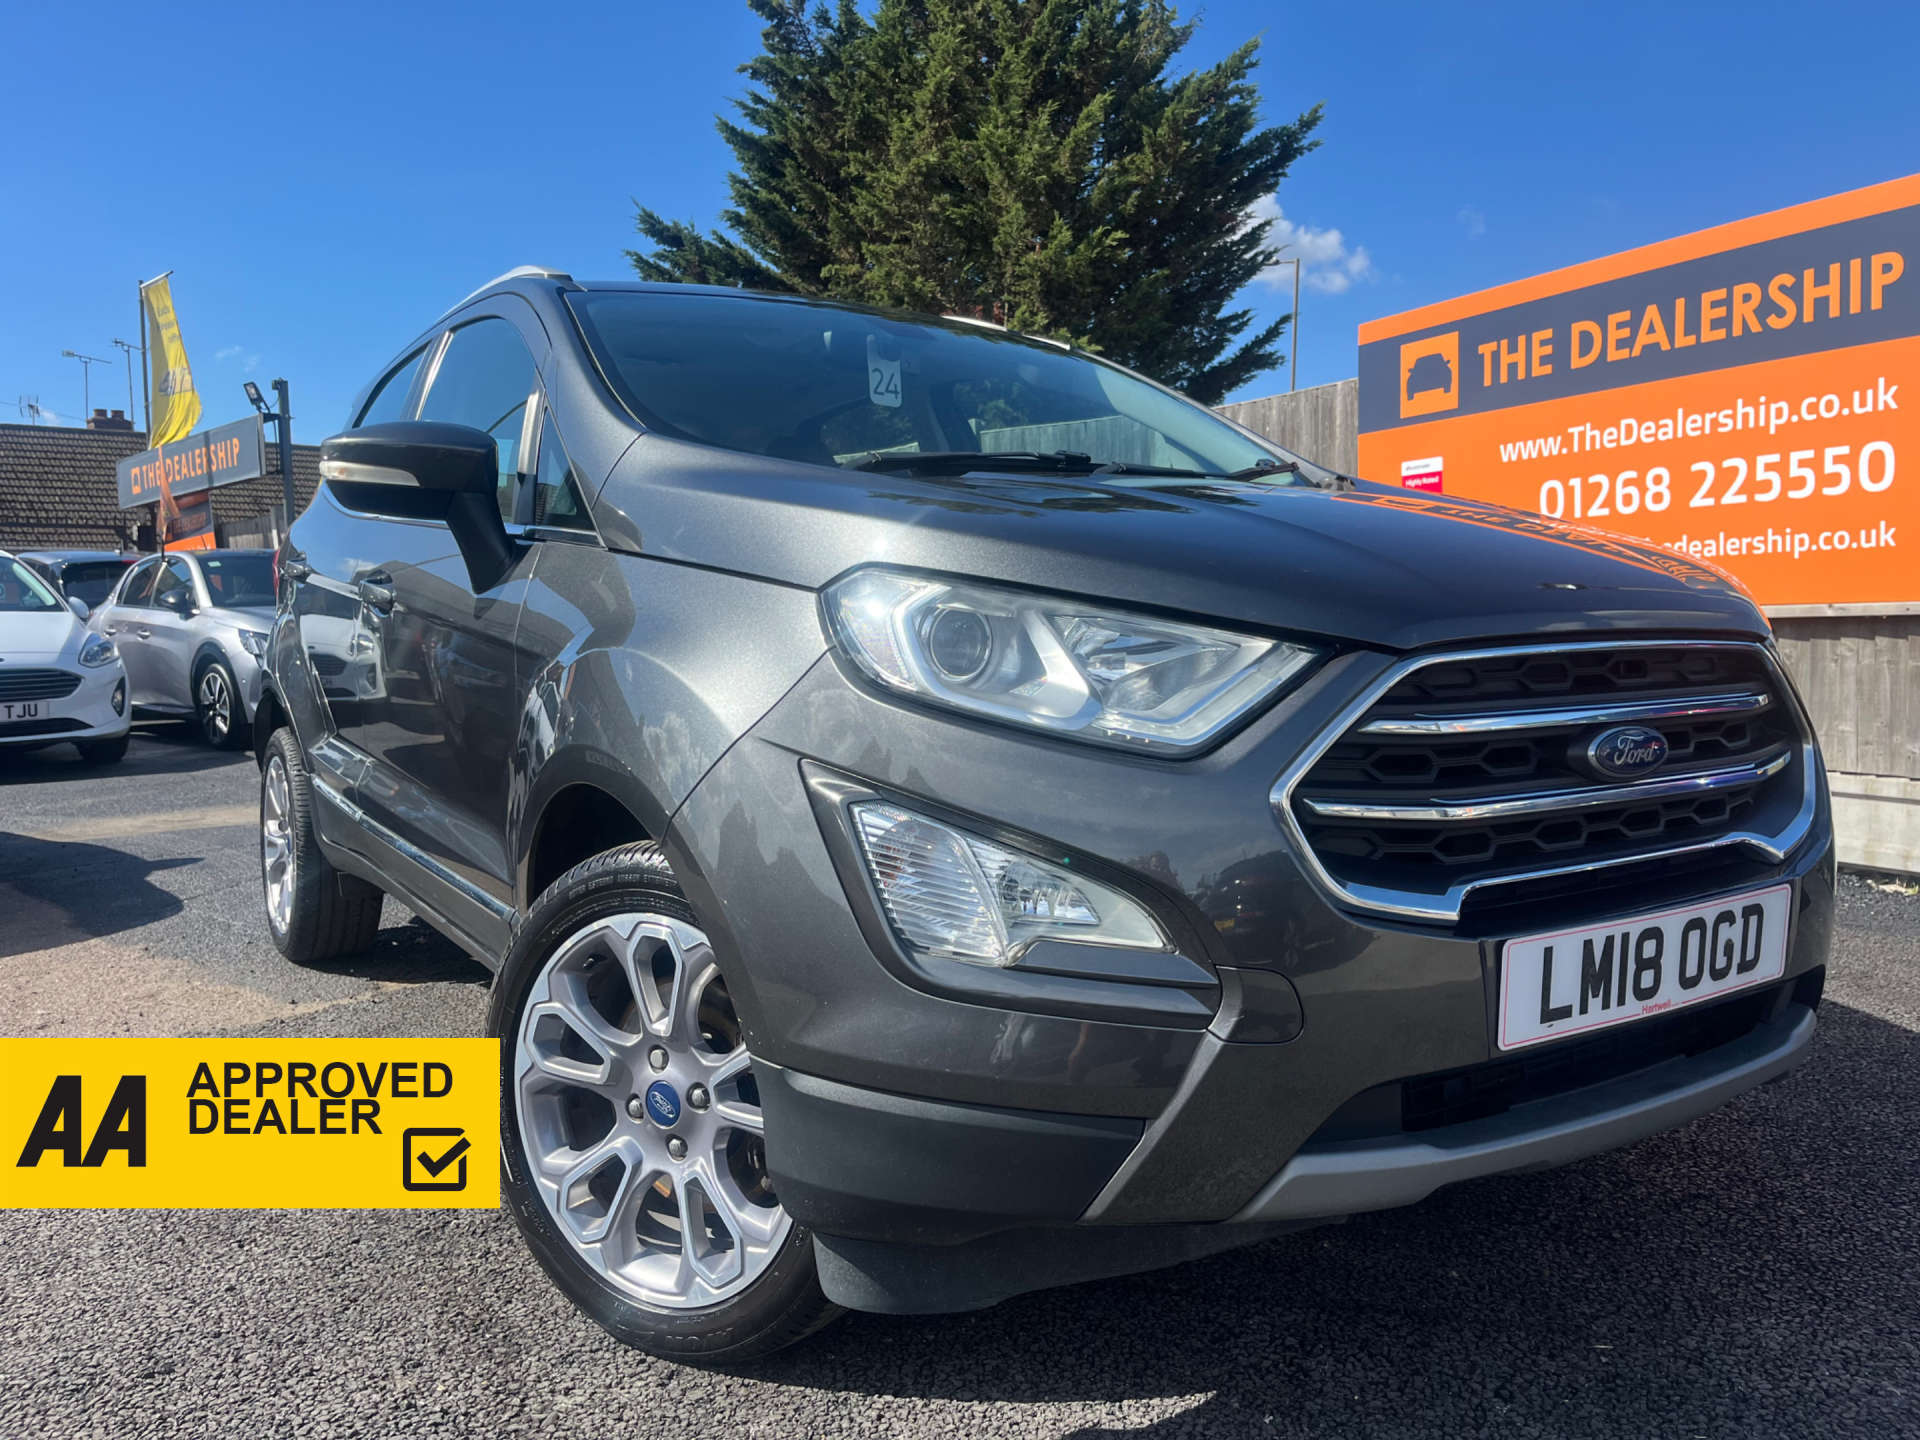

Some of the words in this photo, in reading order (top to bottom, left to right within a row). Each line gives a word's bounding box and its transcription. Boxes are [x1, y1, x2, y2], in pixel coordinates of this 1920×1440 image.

[1478, 328, 1554, 388] THE
[1570, 251, 1905, 370] DEALERSHIP
[872, 367, 901, 401] 24
[1499, 376, 1900, 463] www.TheDealership.co.uk
[142, 460, 161, 489] THE
[165, 437, 240, 483] DEALERSHIP
[1539, 466, 1671, 519] 01268
[1689, 440, 1896, 508] 225550
[4, 703, 38, 719] TJU
[1614, 735, 1657, 765] Ford
[1540, 926, 1664, 1024] LM18
[1678, 903, 1764, 990] OGD
